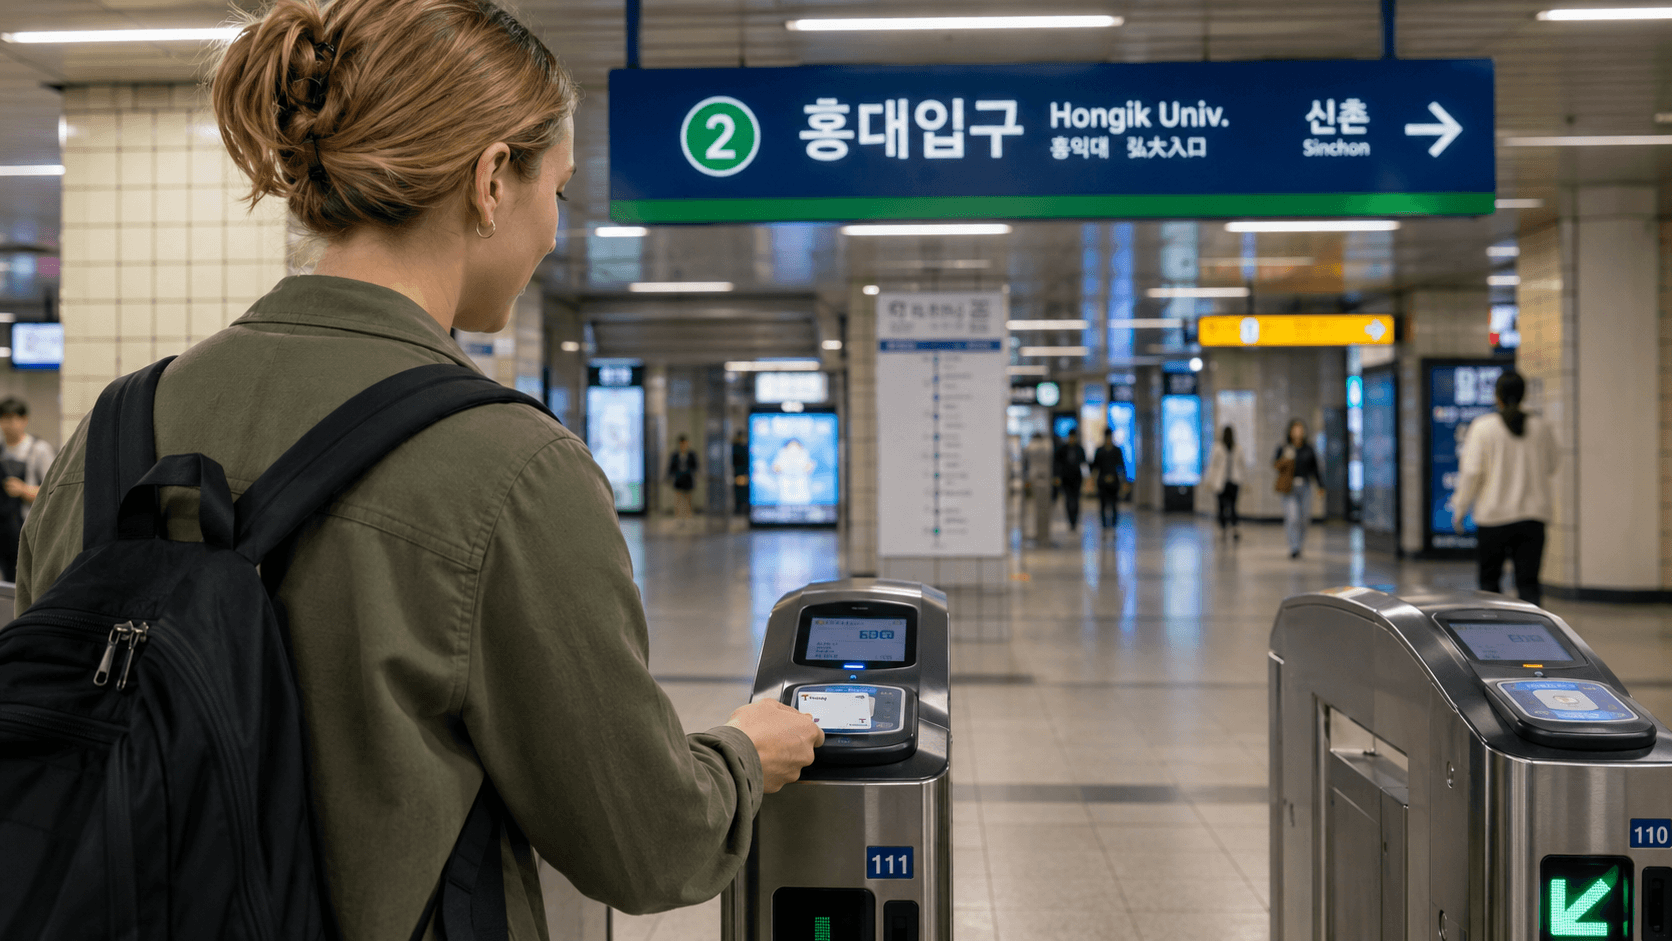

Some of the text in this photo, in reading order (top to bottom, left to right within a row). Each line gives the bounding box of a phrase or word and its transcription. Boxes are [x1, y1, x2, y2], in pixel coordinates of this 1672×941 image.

[799, 97, 1025, 161] 홍대입구
[1050, 100, 1230, 134] Hongik Univ.
[1305, 98, 1370, 135] 신촌
[705, 113, 737, 160] 2
[1303, 138, 1371, 157] Sinchon
[1634, 826, 1668, 844] 110
[871, 854, 908, 874] 111
